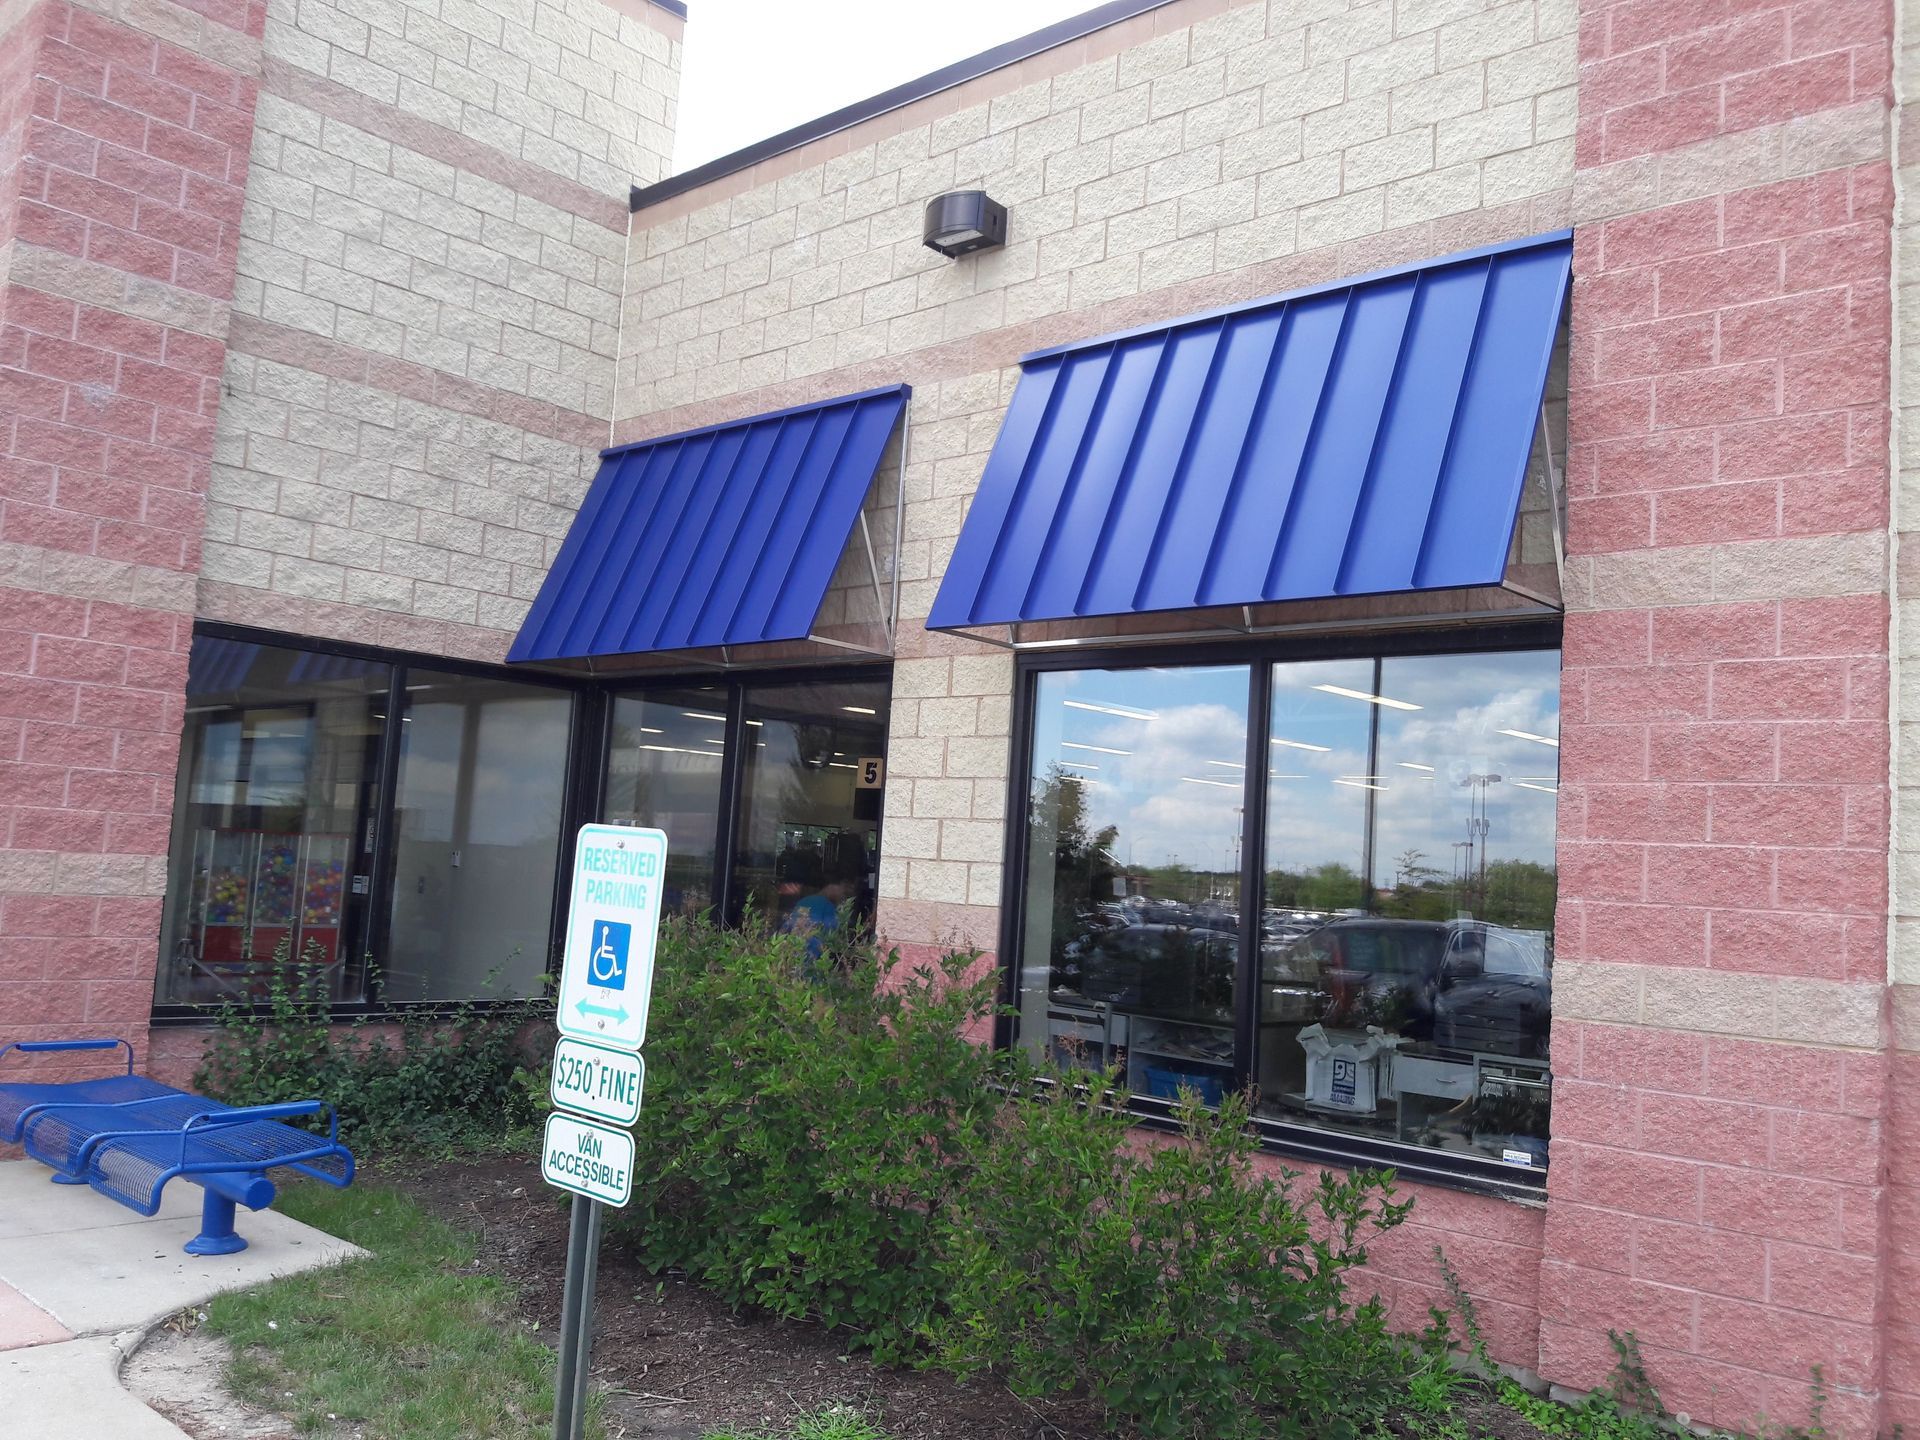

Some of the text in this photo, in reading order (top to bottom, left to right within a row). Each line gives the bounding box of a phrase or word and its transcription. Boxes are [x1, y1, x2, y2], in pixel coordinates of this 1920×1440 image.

[864, 762, 878, 784] 5
[583, 847, 657, 878] RESERVED
[585, 878, 647, 910] PARKING
[557, 1053, 637, 1106] $250 FINE
[577, 1133, 602, 1160] VAN
[548, 1149, 625, 1191] ACCESSIBLE
